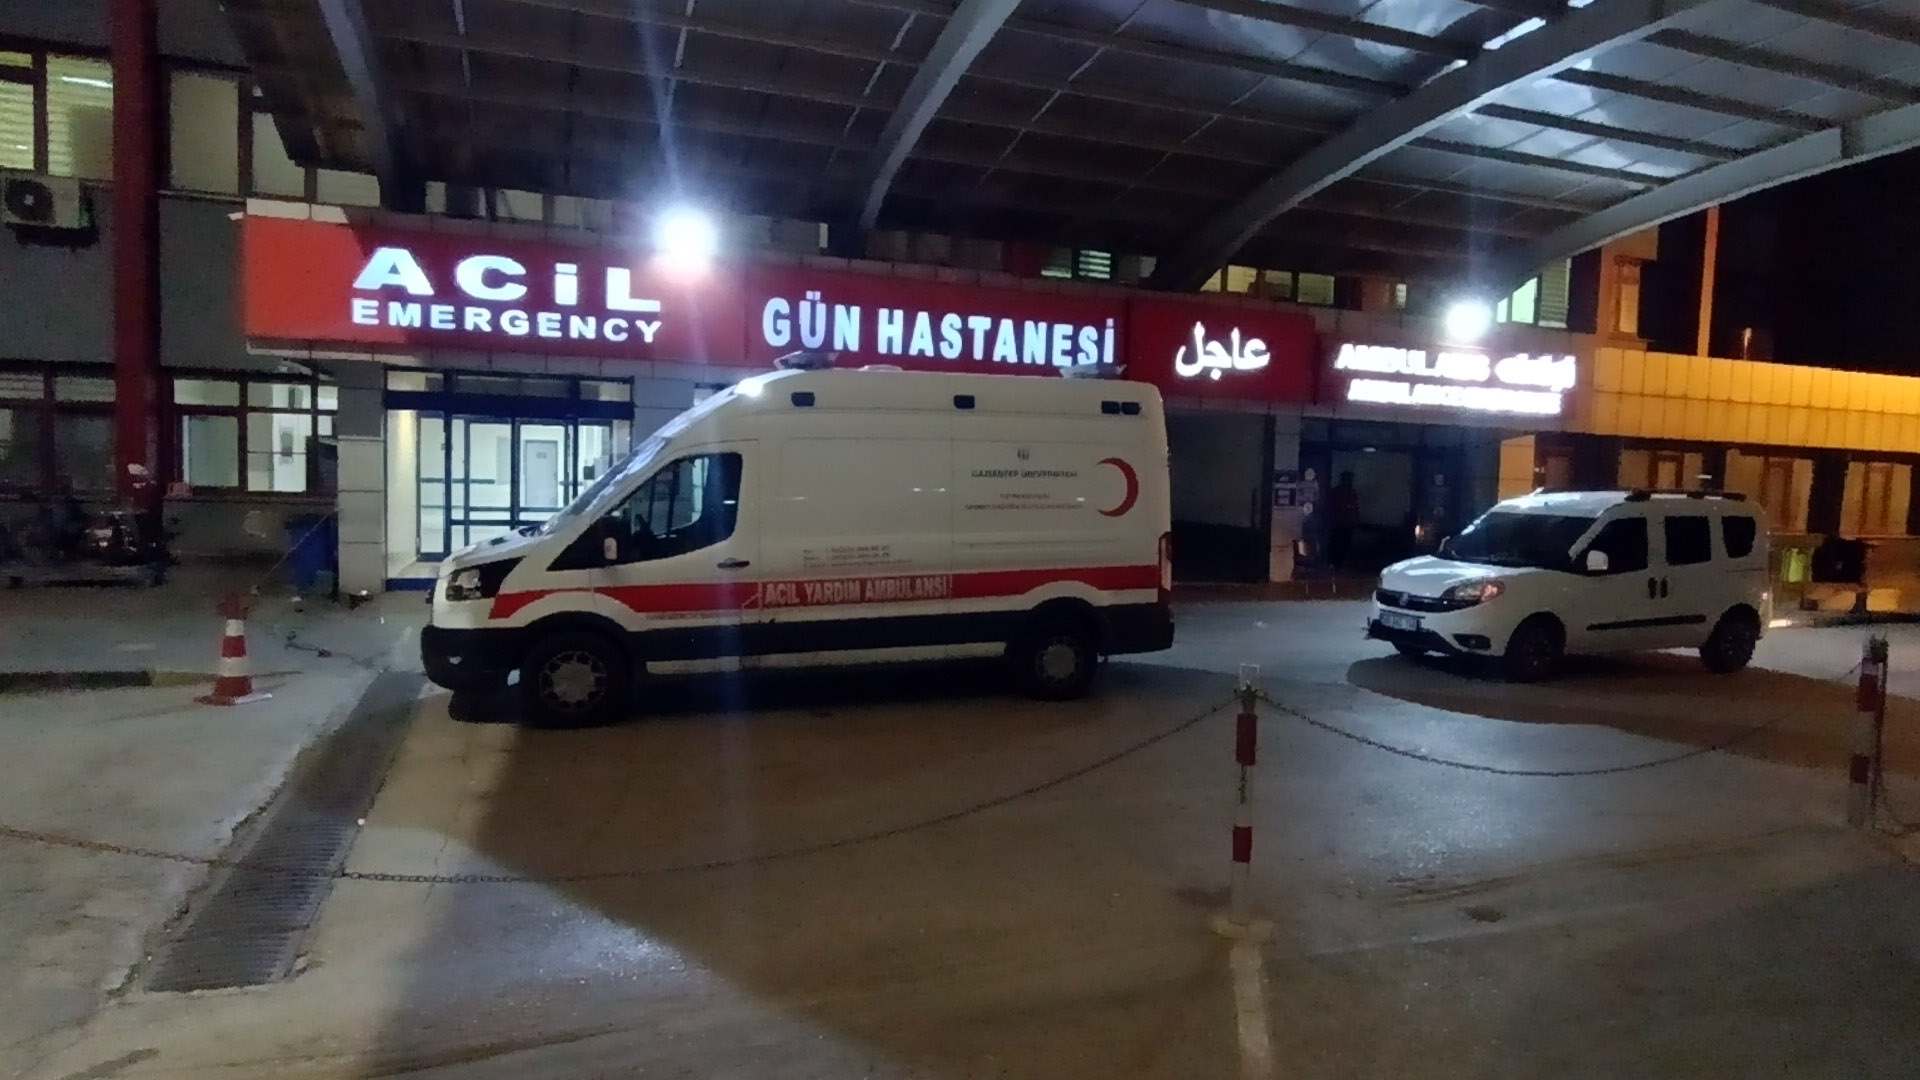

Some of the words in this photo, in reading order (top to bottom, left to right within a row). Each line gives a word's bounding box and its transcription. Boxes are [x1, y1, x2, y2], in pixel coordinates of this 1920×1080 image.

[352, 298, 662, 343] EMERGENCY
[763, 291, 860, 352] GÜN
[877, 308, 1115, 367] HASTANESİ
[1175, 321, 1270, 380] عاجل
